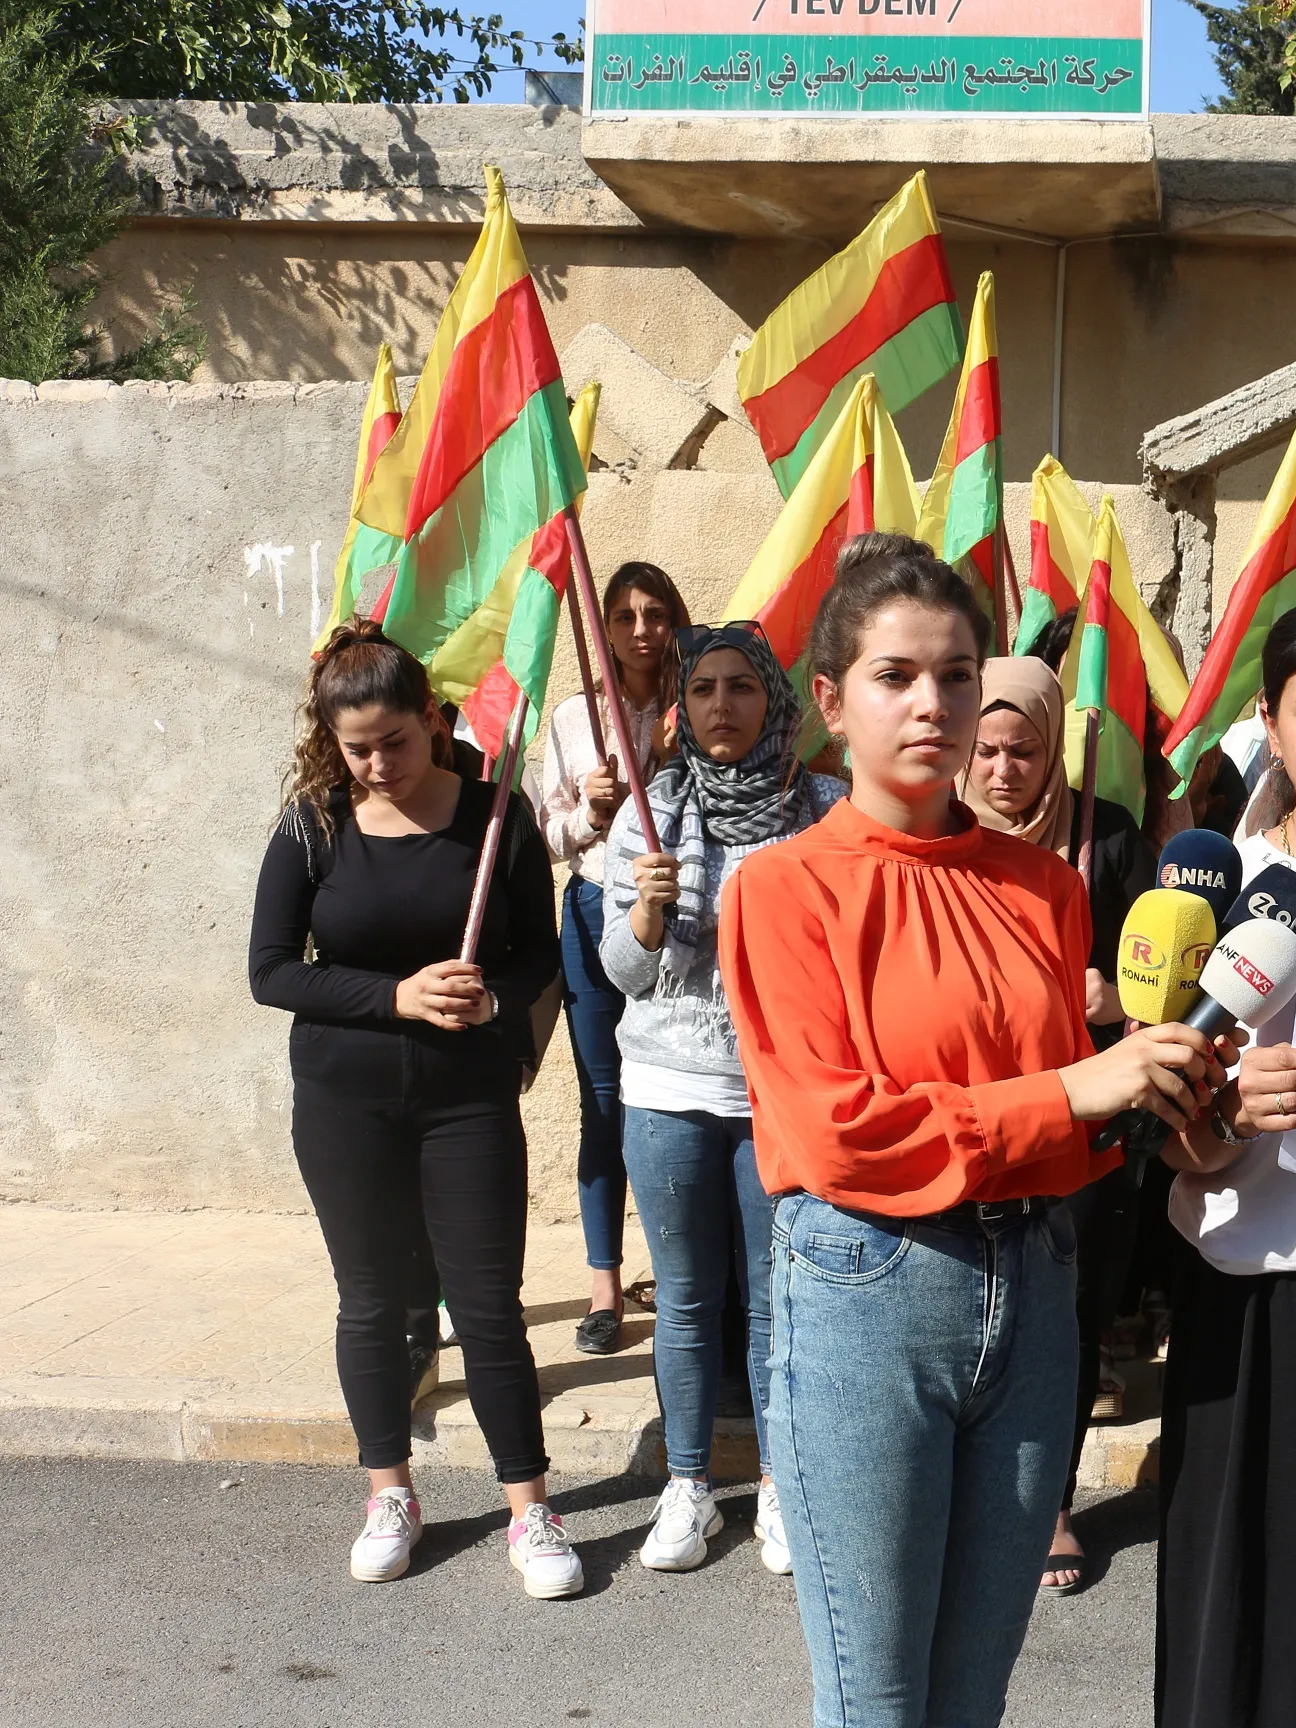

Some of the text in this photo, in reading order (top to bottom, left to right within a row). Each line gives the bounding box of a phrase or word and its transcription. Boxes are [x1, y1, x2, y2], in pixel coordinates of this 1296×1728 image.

[602, 50, 1133, 98] حركة المجتمع الديمقراطي في إقليم الفرات
[1166, 865, 1226, 889] ANHA
[1132, 941, 1152, 965] R
[1216, 943, 1273, 993] ANF NEWS
